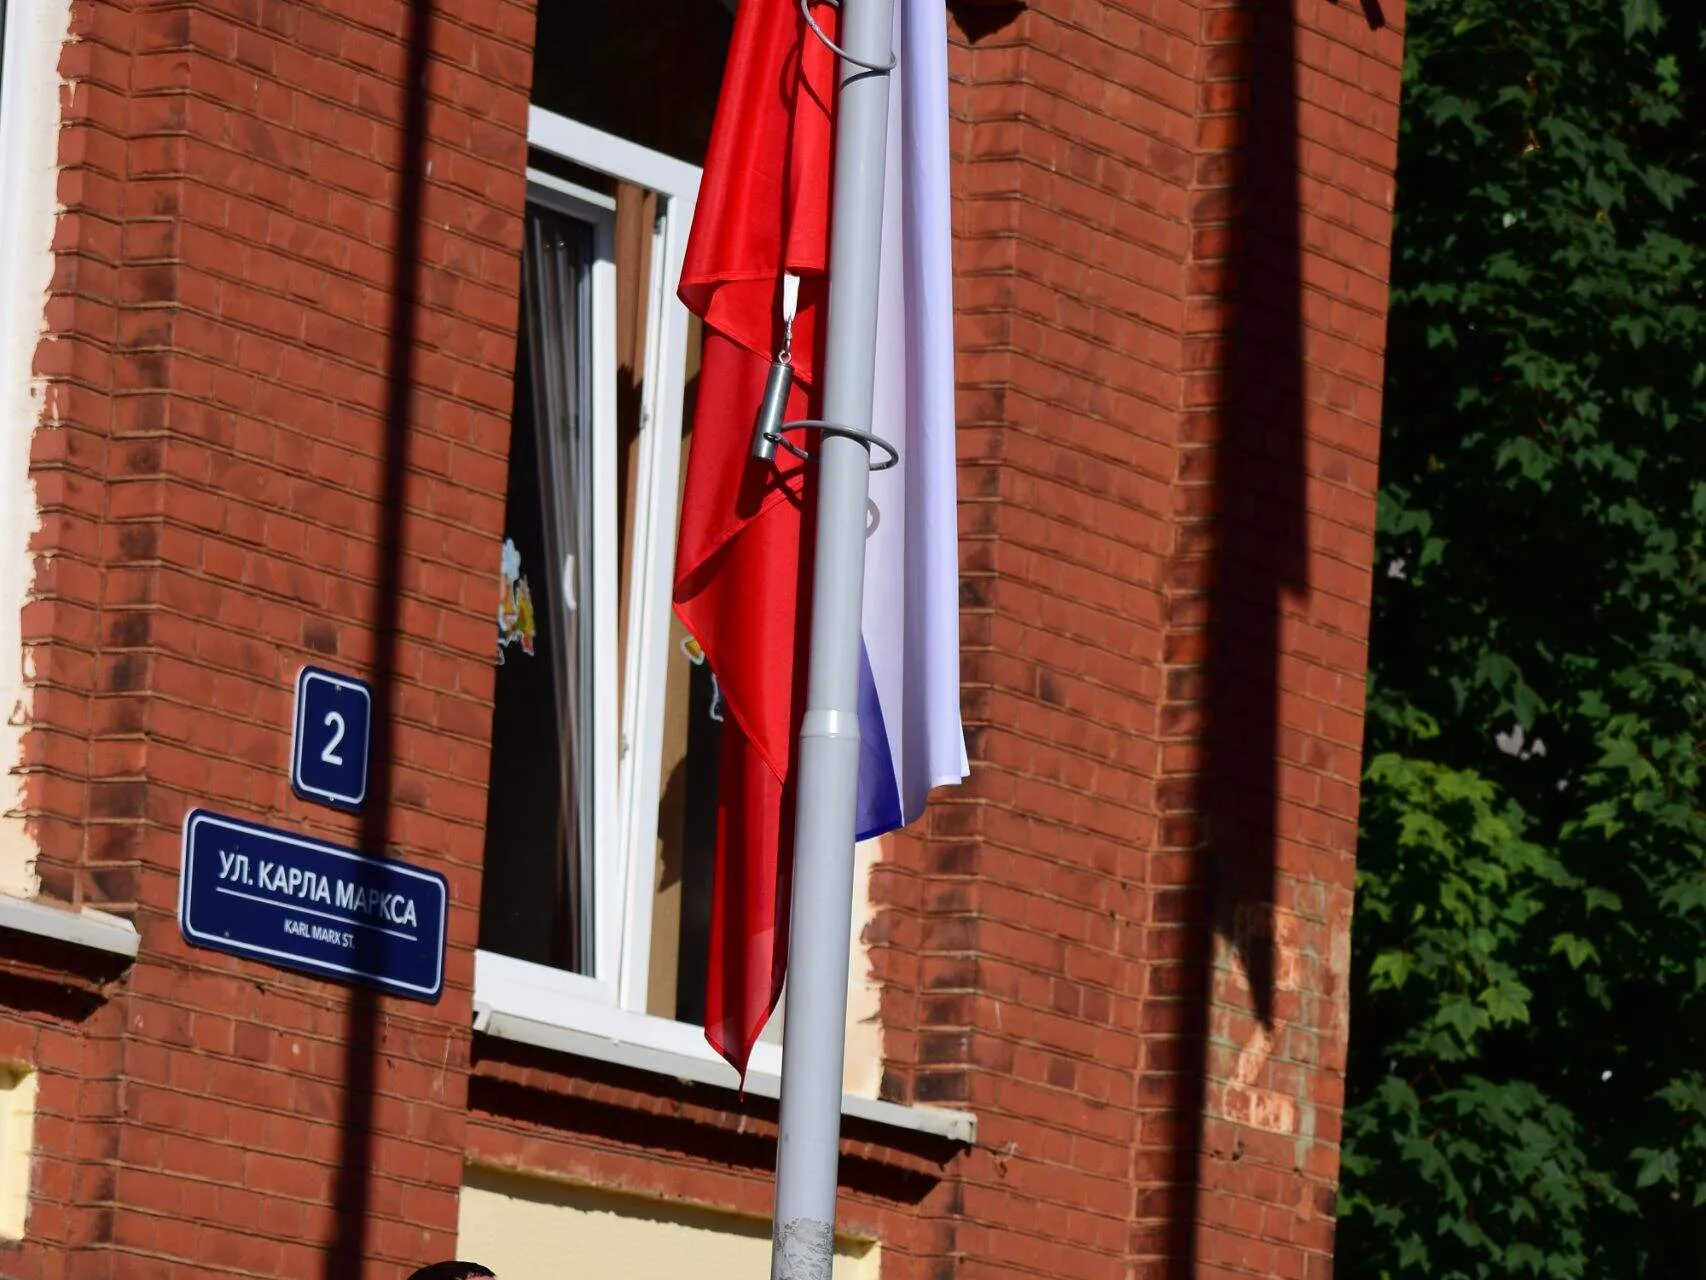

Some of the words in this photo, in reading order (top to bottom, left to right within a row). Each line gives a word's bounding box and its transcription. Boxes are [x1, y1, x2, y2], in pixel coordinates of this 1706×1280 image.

[321, 711, 345, 765] 2
[219, 850, 253, 886] УЛ.
[258, 860, 331, 905] КАРЛА
[335, 879, 418, 928] МАРКСА
[284, 919, 310, 938] KARL
[311, 926, 341, 946] MARX
[342, 934, 356, 949] ST.
